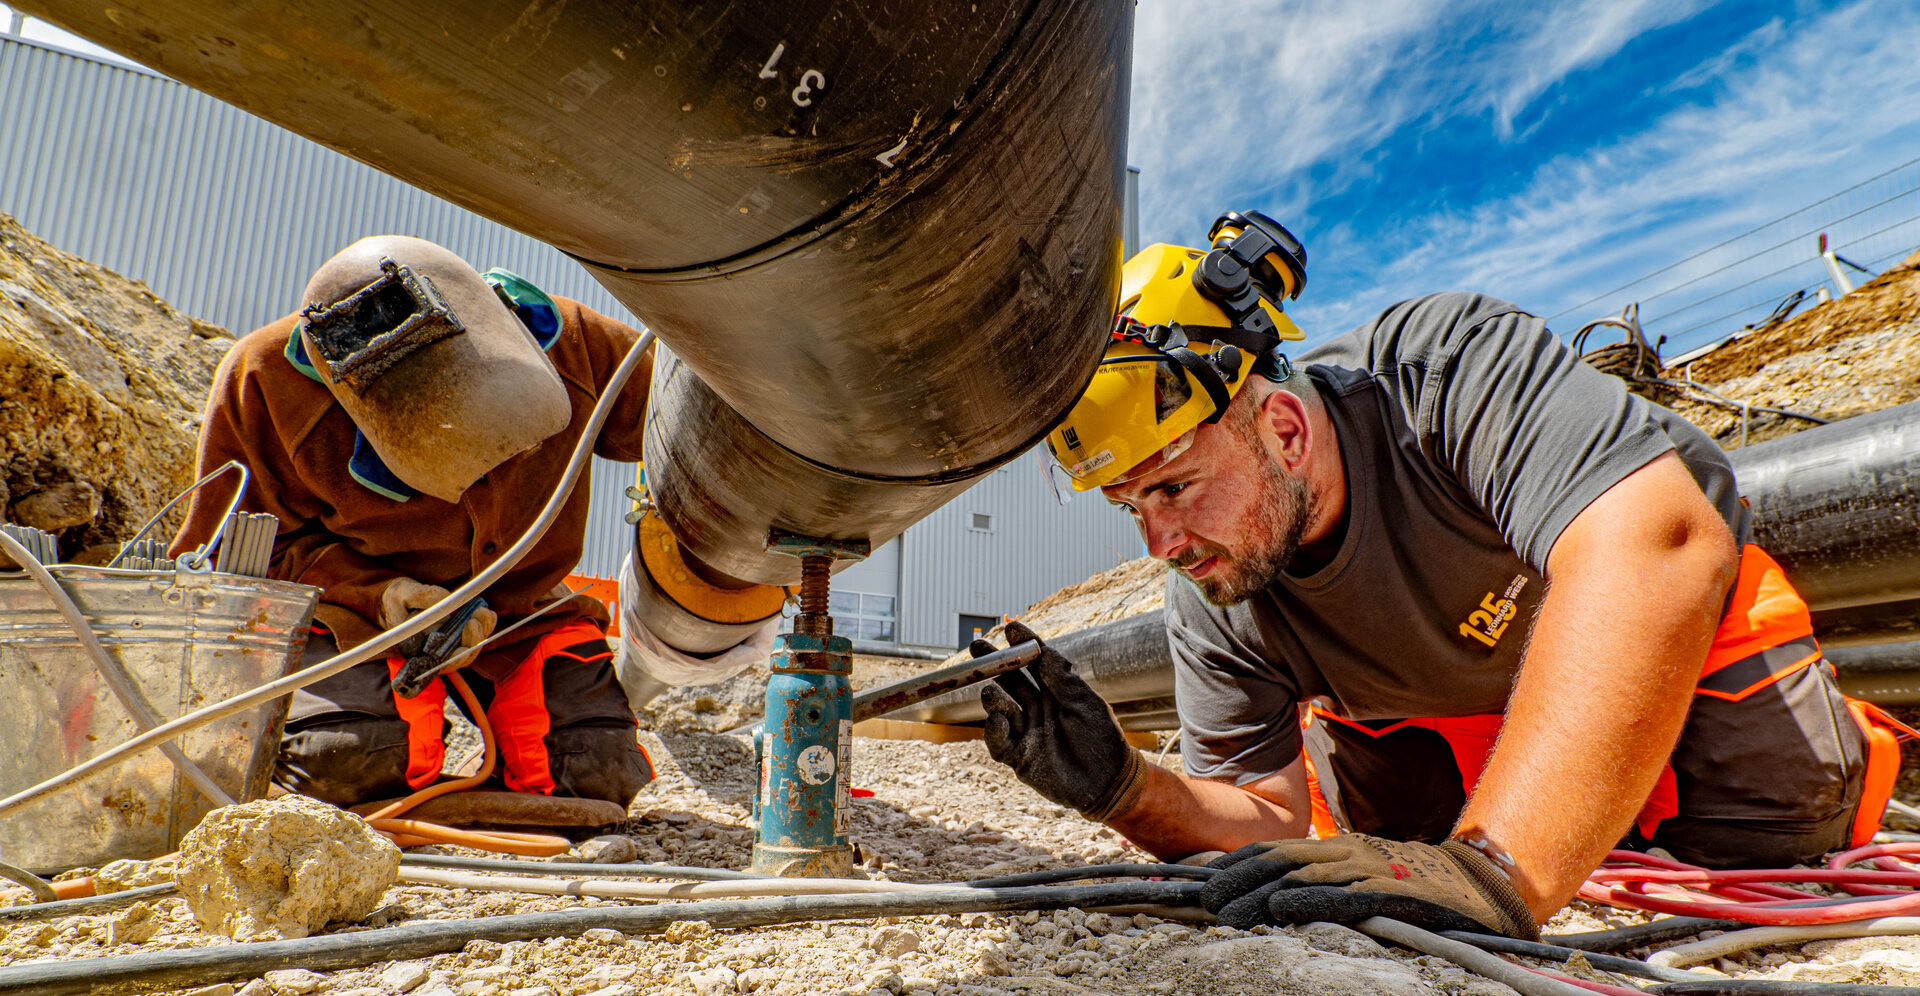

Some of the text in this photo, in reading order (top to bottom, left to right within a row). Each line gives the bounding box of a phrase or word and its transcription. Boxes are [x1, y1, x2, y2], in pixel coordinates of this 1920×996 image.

[1459, 591, 1517, 647] 125
[1484, 576, 1528, 636] LEONHARD WEISS
